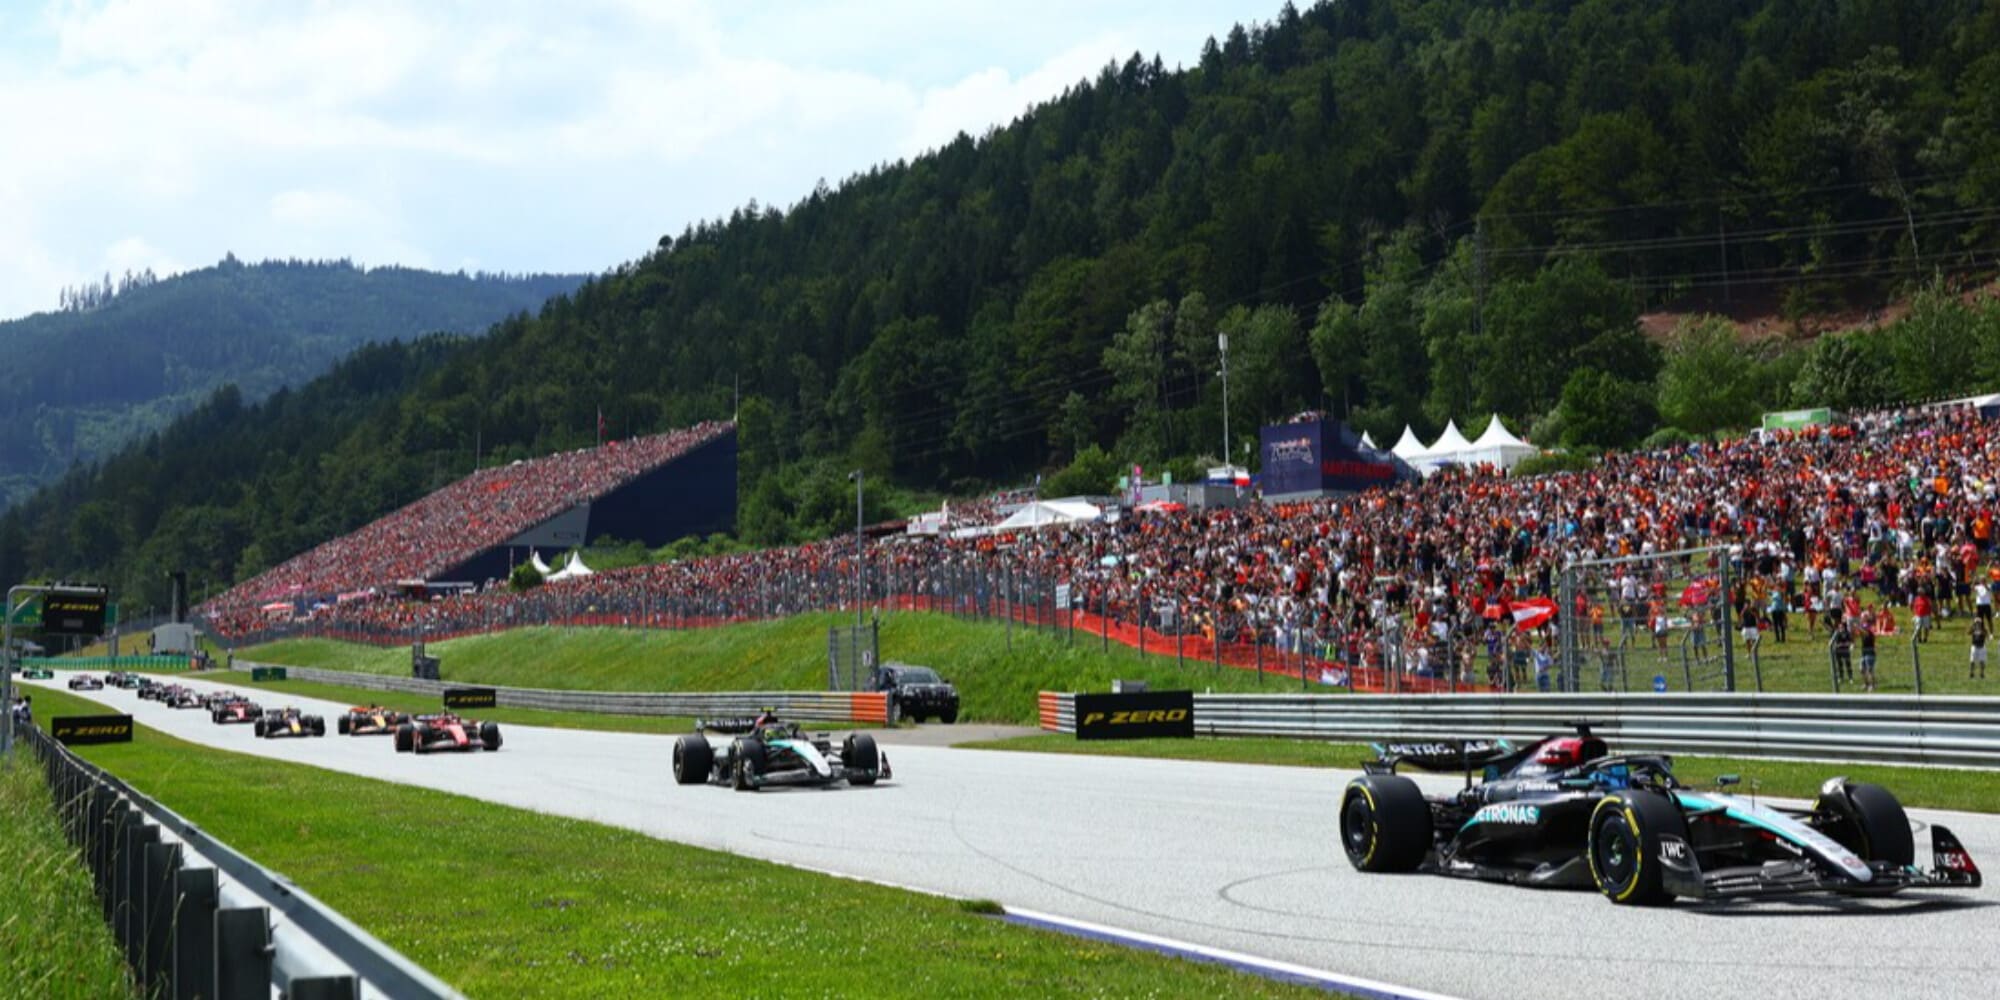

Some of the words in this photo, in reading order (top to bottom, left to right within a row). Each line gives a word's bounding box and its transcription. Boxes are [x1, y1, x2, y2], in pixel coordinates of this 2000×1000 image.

[1083, 712, 1105, 726] P
[1108, 709, 1188, 725] ZERO
[56, 727, 72, 737] P
[74, 725, 129, 736] ZERO
[1660, 841, 1685, 858] IWC
